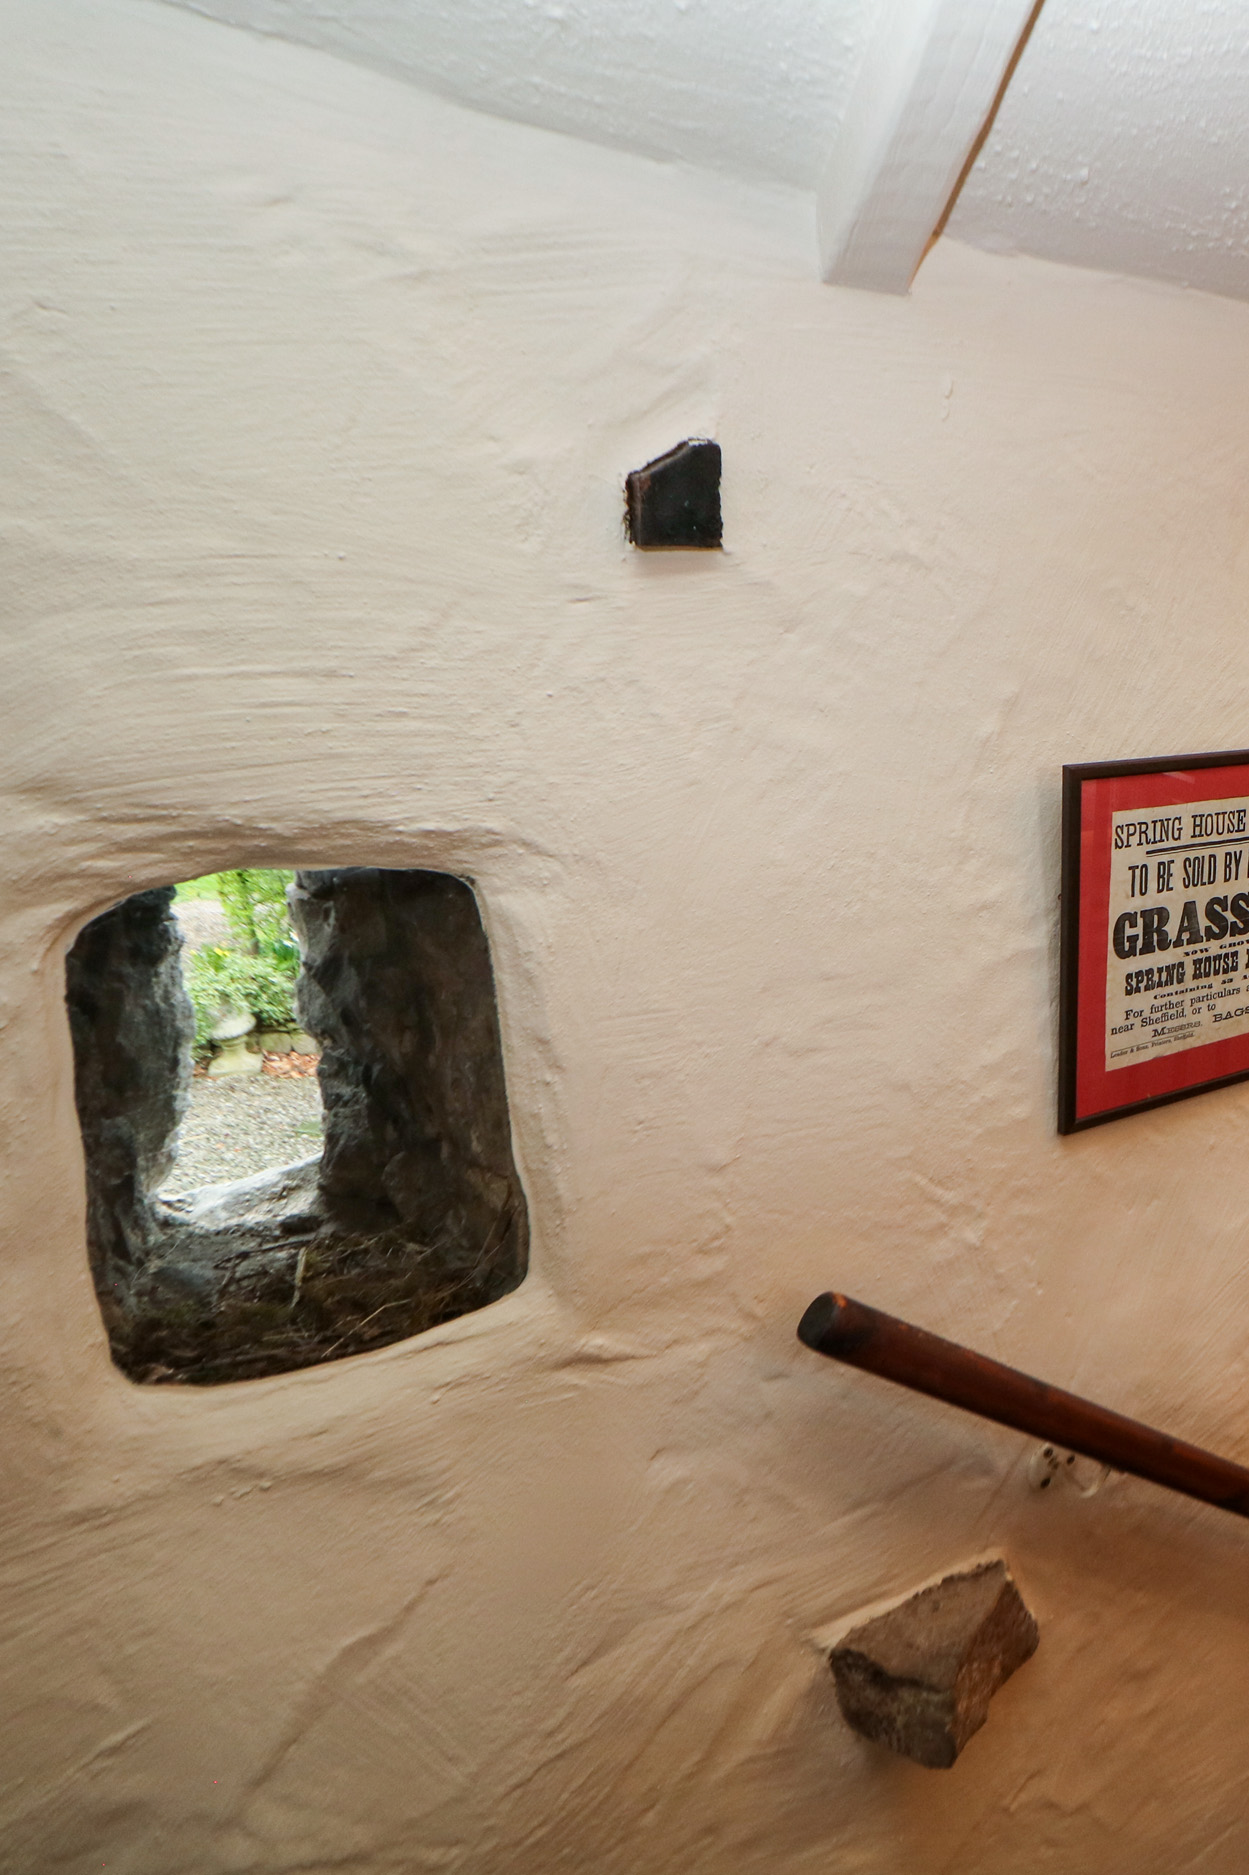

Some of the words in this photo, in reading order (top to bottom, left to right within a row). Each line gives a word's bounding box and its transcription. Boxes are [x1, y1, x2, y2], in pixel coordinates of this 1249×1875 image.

[1114, 816, 1183, 849] SPRING
[1191, 809, 1246, 838] HOUSE
[1128, 863, 1148, 897] TO
[1157, 860, 1175, 893] BE
[1183, 854, 1216, 888] SOLD
[1224, 850, 1242, 882] BY
[1183, 946, 1211, 957] NOW
[1125, 961, 1186, 996] SPRING
[1192, 950, 1239, 981] HOUSE
[1125, 1009, 1144, 1020] For
[1150, 999, 1185, 1014] further
[1190, 987, 1240, 1007] particulars
[1153, 982, 1213, 1000] Containing
[1111, 1023, 1134, 1035] near
[1141, 1010, 1187, 1027] Sheffield,
[1192, 1007, 1202, 1015] or
[1208, 1003, 1216, 1011] to
